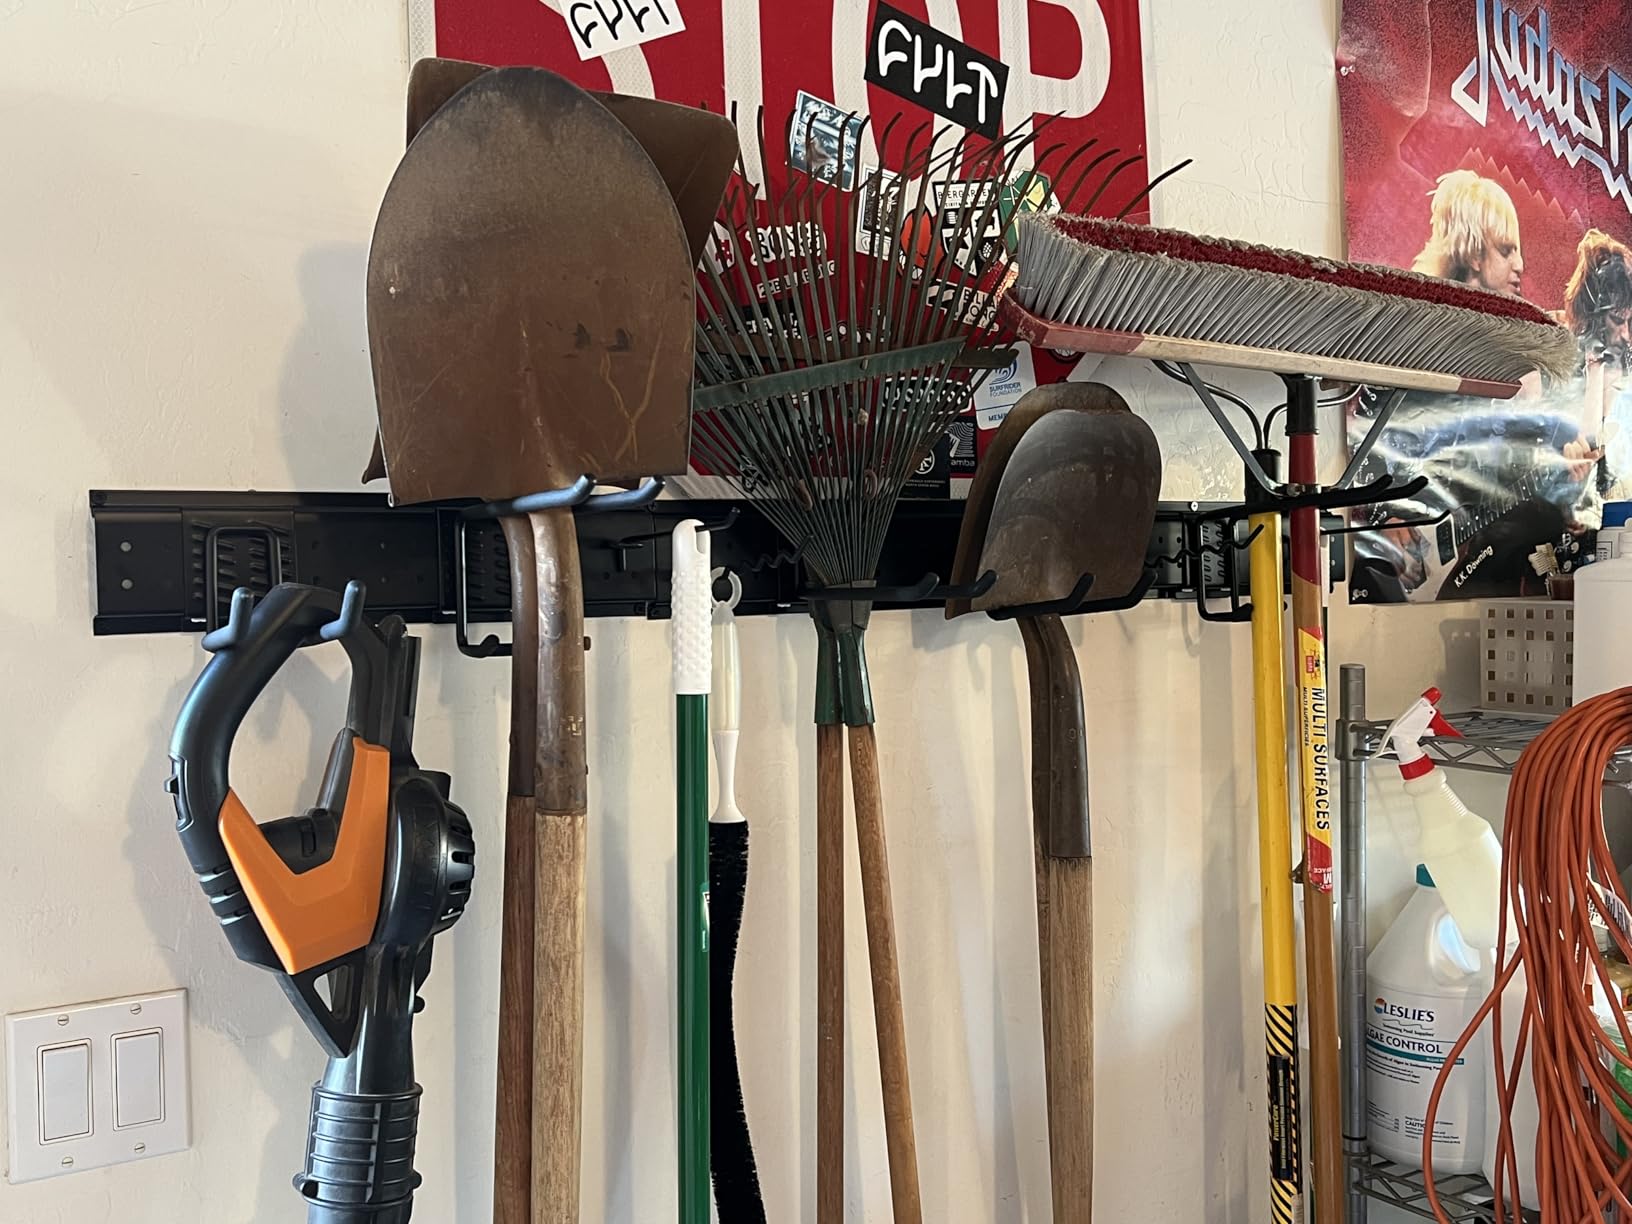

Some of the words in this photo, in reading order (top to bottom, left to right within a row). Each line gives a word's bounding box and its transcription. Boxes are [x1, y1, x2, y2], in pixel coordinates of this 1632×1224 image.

[1465, 545, 1493, 575] Downing
[1312, 687, 1326, 737] MULTI
[1313, 743, 1330, 831] SURFACES
[1386, 1036, 1443, 1054] CONTROL
